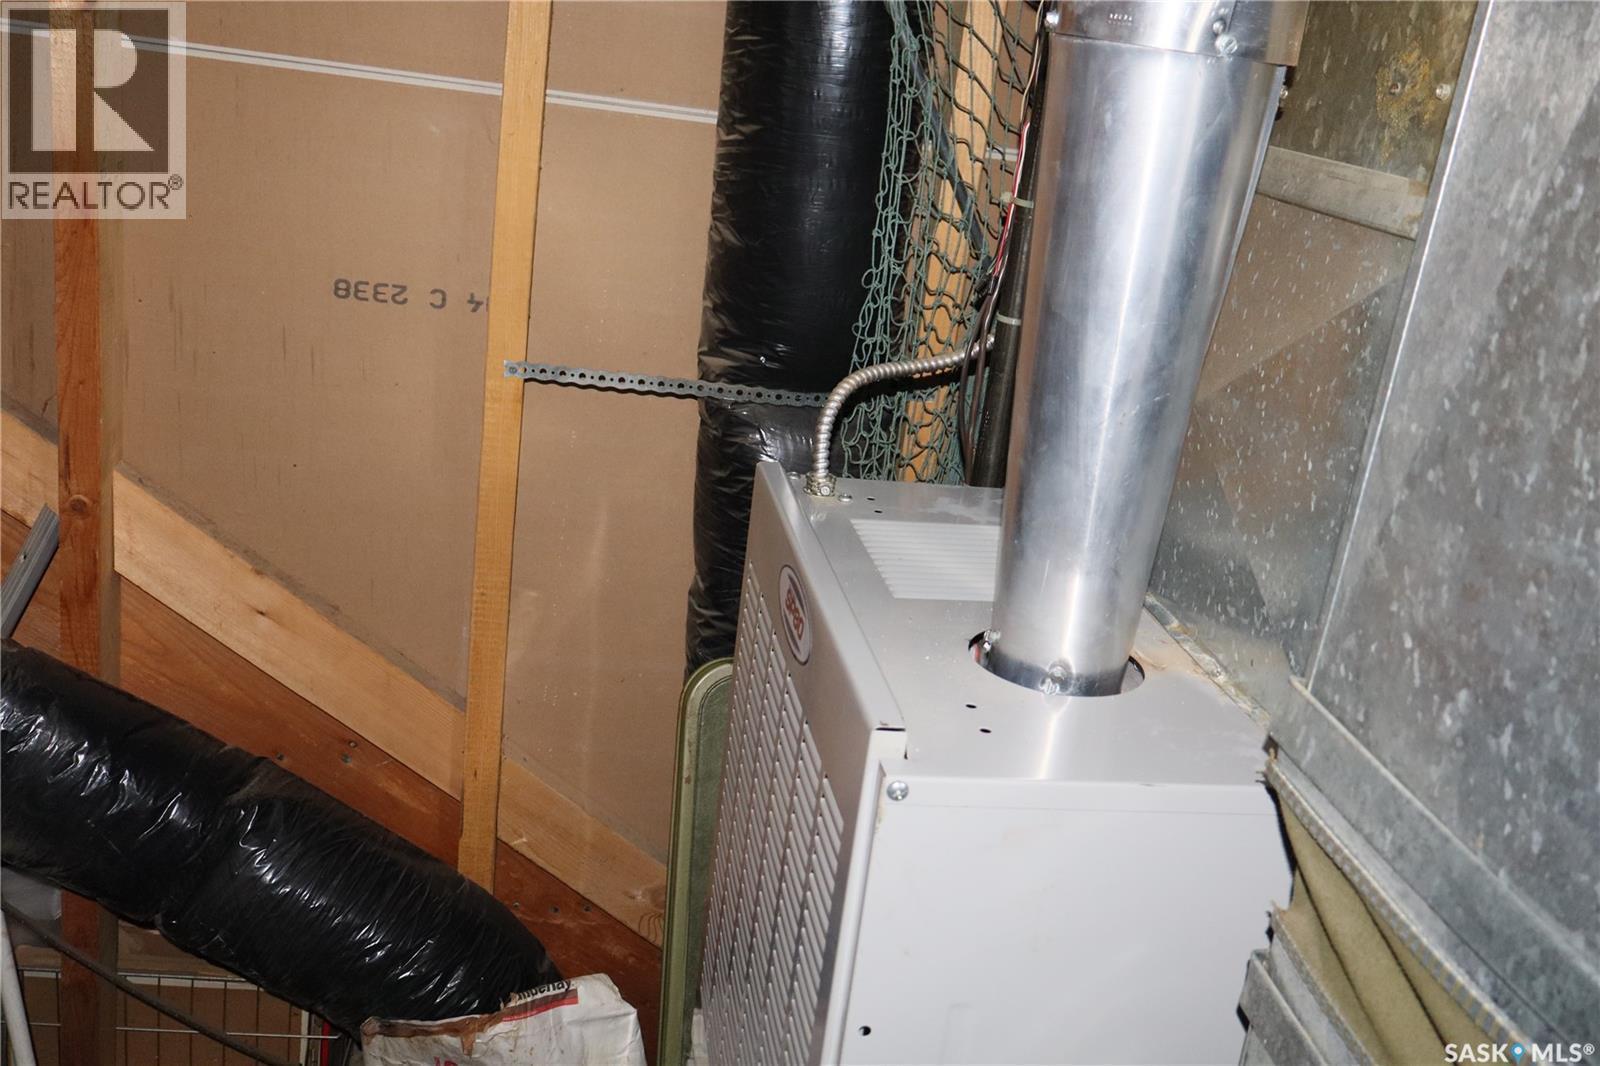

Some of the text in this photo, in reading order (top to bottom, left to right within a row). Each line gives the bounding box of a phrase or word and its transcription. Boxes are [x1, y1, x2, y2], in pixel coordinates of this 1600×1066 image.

[333, 278, 489, 313] 4 C 2338
